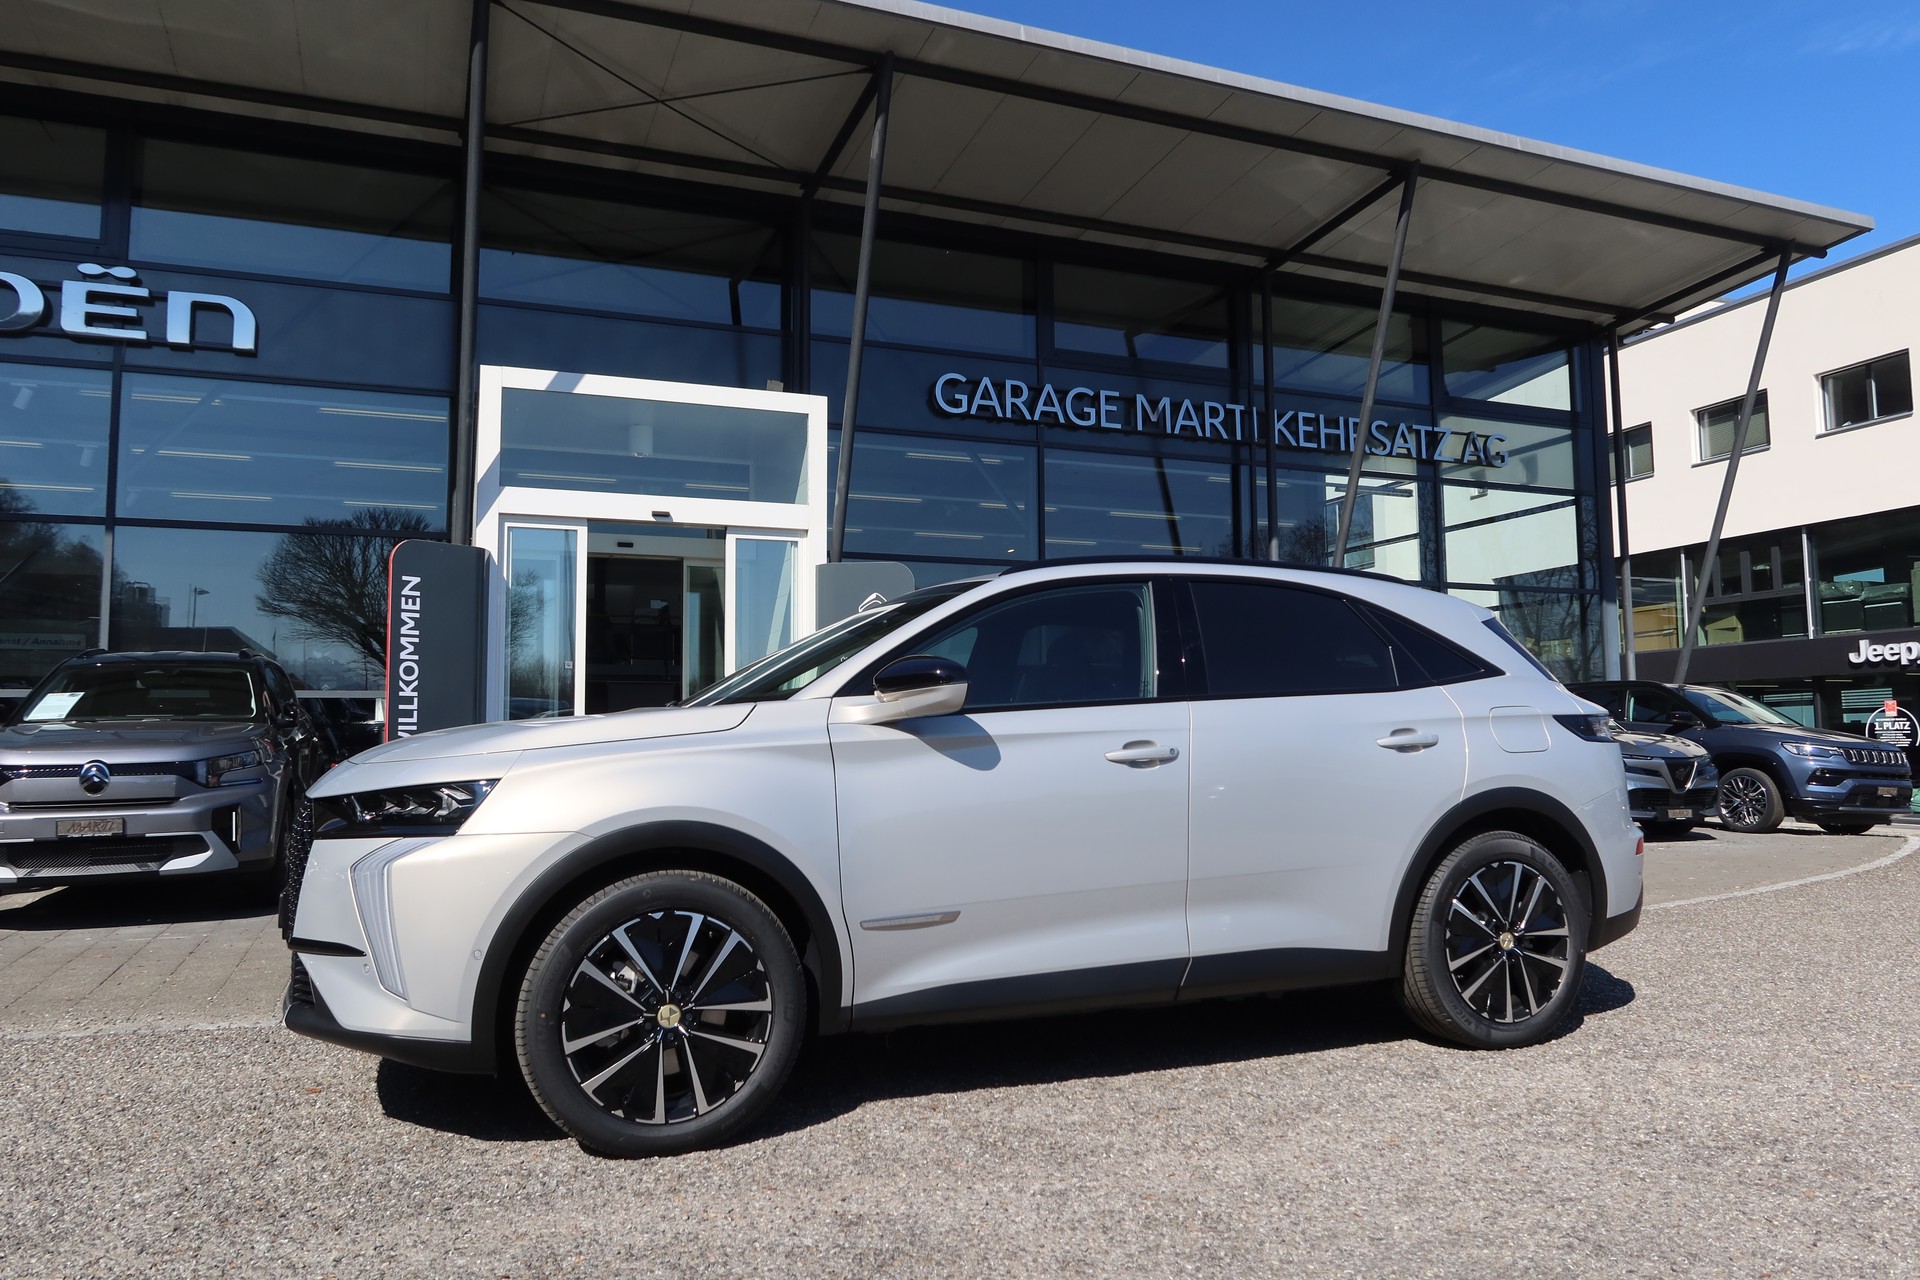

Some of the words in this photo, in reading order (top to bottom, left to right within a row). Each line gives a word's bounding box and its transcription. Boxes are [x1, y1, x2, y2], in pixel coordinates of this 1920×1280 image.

[935, 372, 1122, 429] GARAGE
[1136, 393, 1258, 442] MARTI
[1463, 430, 1509, 468] AG
[1848, 639, 1920, 665] Jeep
[1883, 721, 1911, 730] PLATZ
